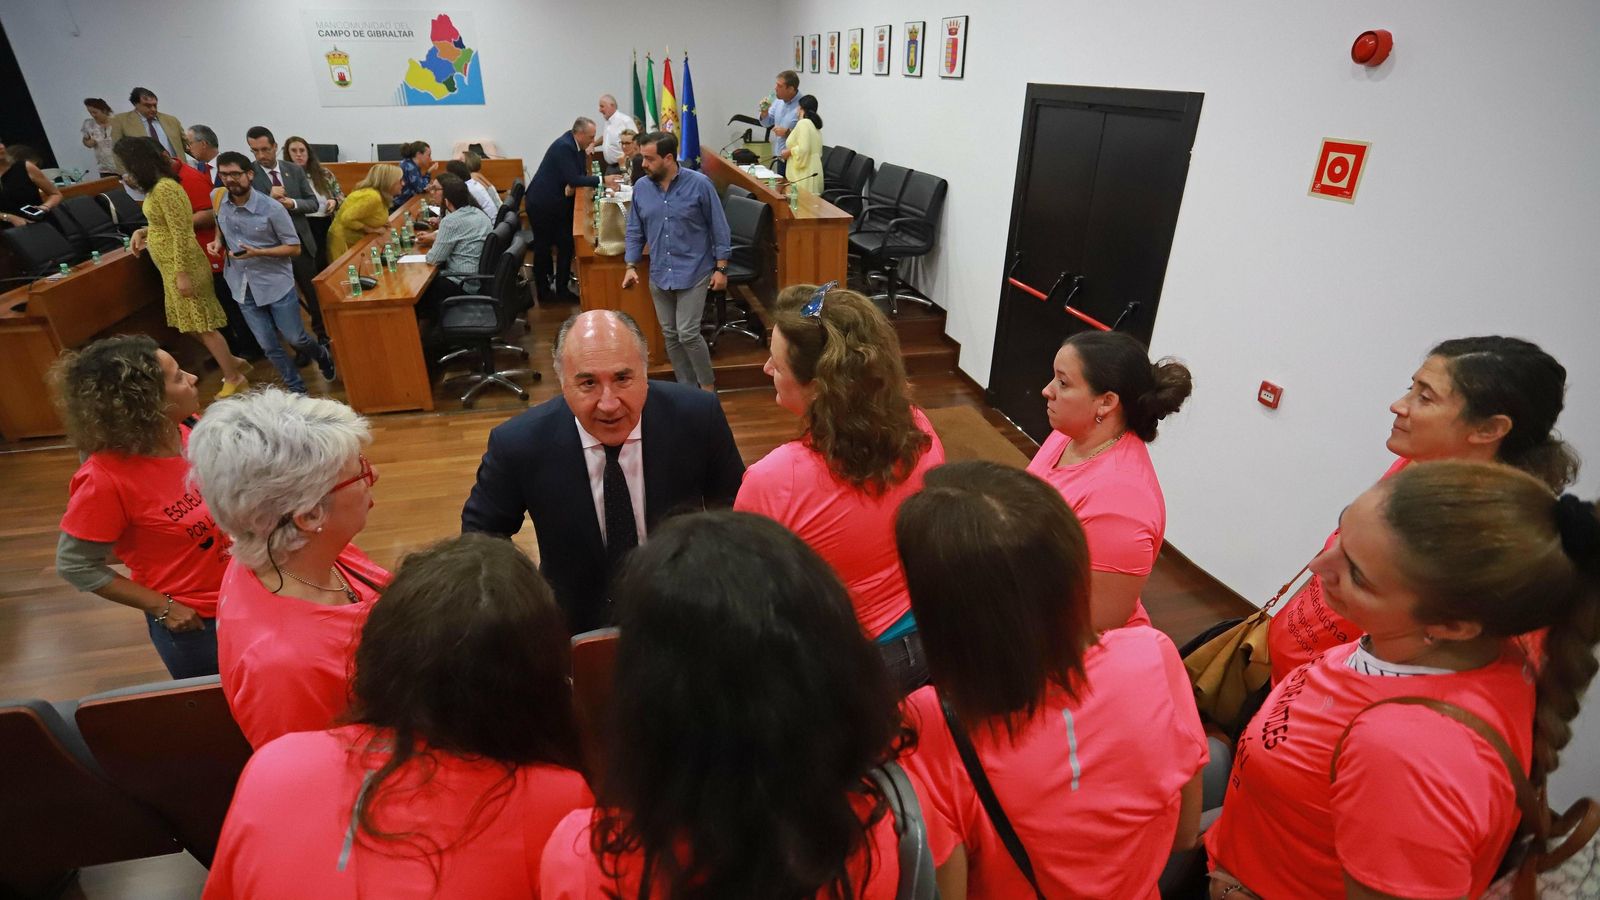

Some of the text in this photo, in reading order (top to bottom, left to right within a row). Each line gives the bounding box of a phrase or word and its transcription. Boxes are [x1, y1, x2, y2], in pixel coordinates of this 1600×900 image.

[315, 21, 411, 30] MANCOMUNIDAD DEL
[317, 29, 415, 38] CAMPO DE GIBRALTAR
[163, 488, 202, 522] ESCUEL
[186, 520, 209, 540] POR
